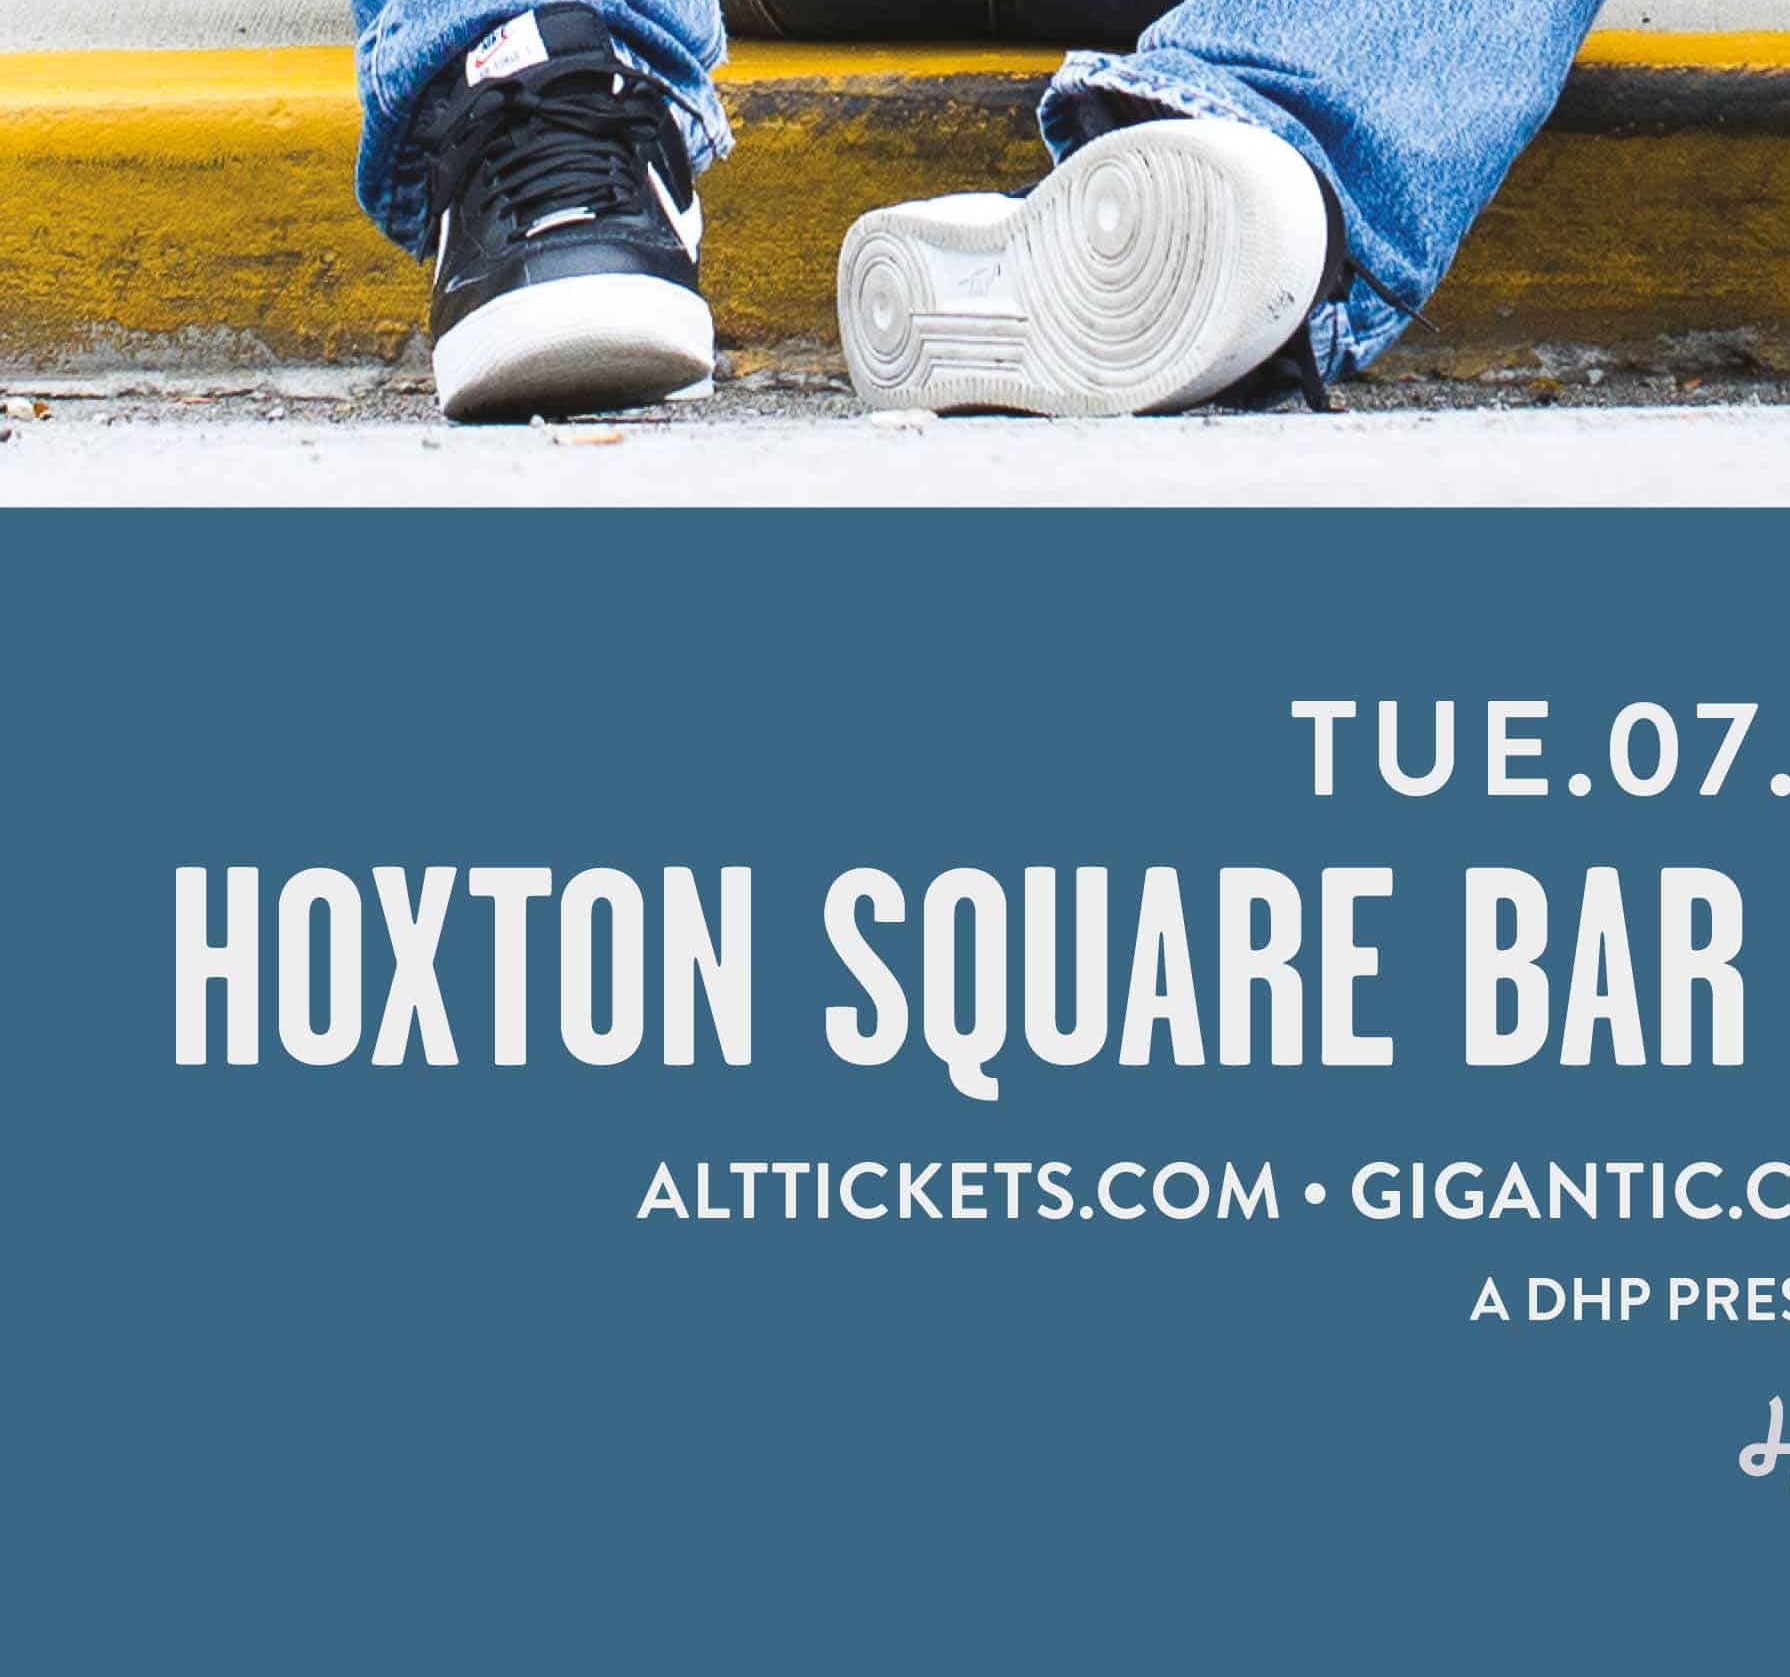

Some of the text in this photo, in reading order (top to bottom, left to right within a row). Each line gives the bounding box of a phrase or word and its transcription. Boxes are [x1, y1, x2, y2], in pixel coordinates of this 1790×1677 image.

[175, 866, 752, 1066] HOXTON
[823, 866, 1394, 1102] SQUARE
[1465, 866, 1744, 1066] BAR
[636, 1161, 1280, 1220] ALTTICKETS.COM
[1469, 1276, 1510, 1321] A
[1528, 1277, 1651, 1321] DHP
